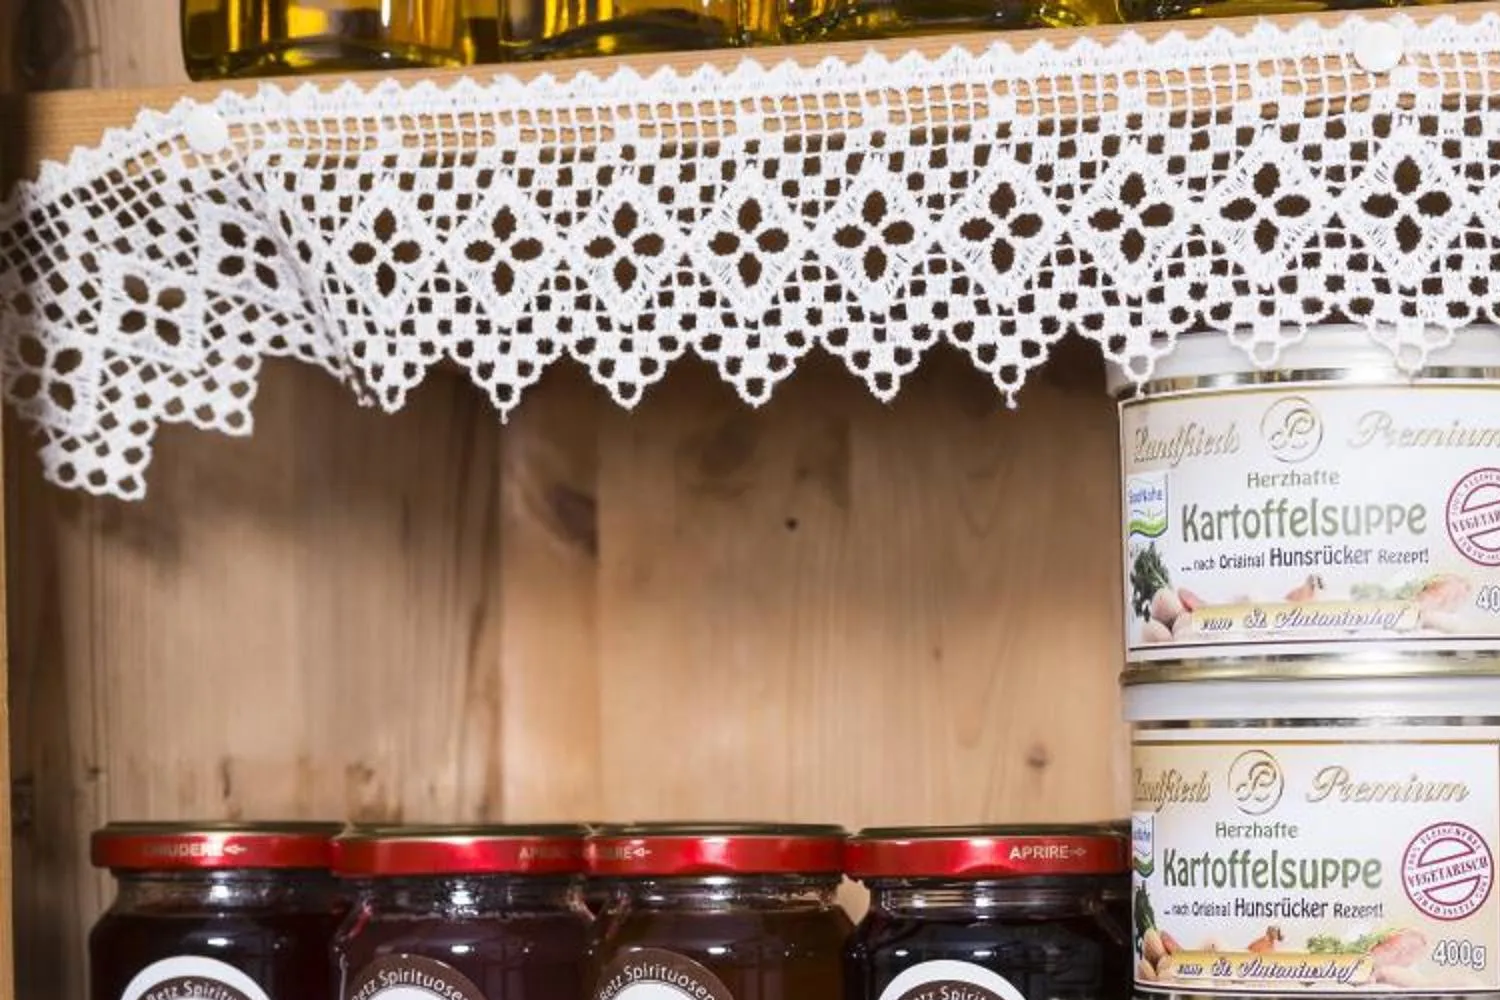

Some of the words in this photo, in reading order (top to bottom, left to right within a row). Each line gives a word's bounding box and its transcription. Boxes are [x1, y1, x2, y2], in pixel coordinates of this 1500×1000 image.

[1247, 470, 1340, 489] Herzhafte
[1182, 501, 1427, 543] Kartoffelsuppe
[1269, 545, 1370, 567] Hunsrücker
[1305, 765, 1470, 803] Premium
[1215, 821, 1298, 839] Herzhafte
[1009, 845, 1069, 860] APRIRE
[1163, 848, 1383, 890] Kartoffelsuppe
[1234, 897, 1329, 919] Hunsrücker
[1432, 939, 1486, 970] 400g
